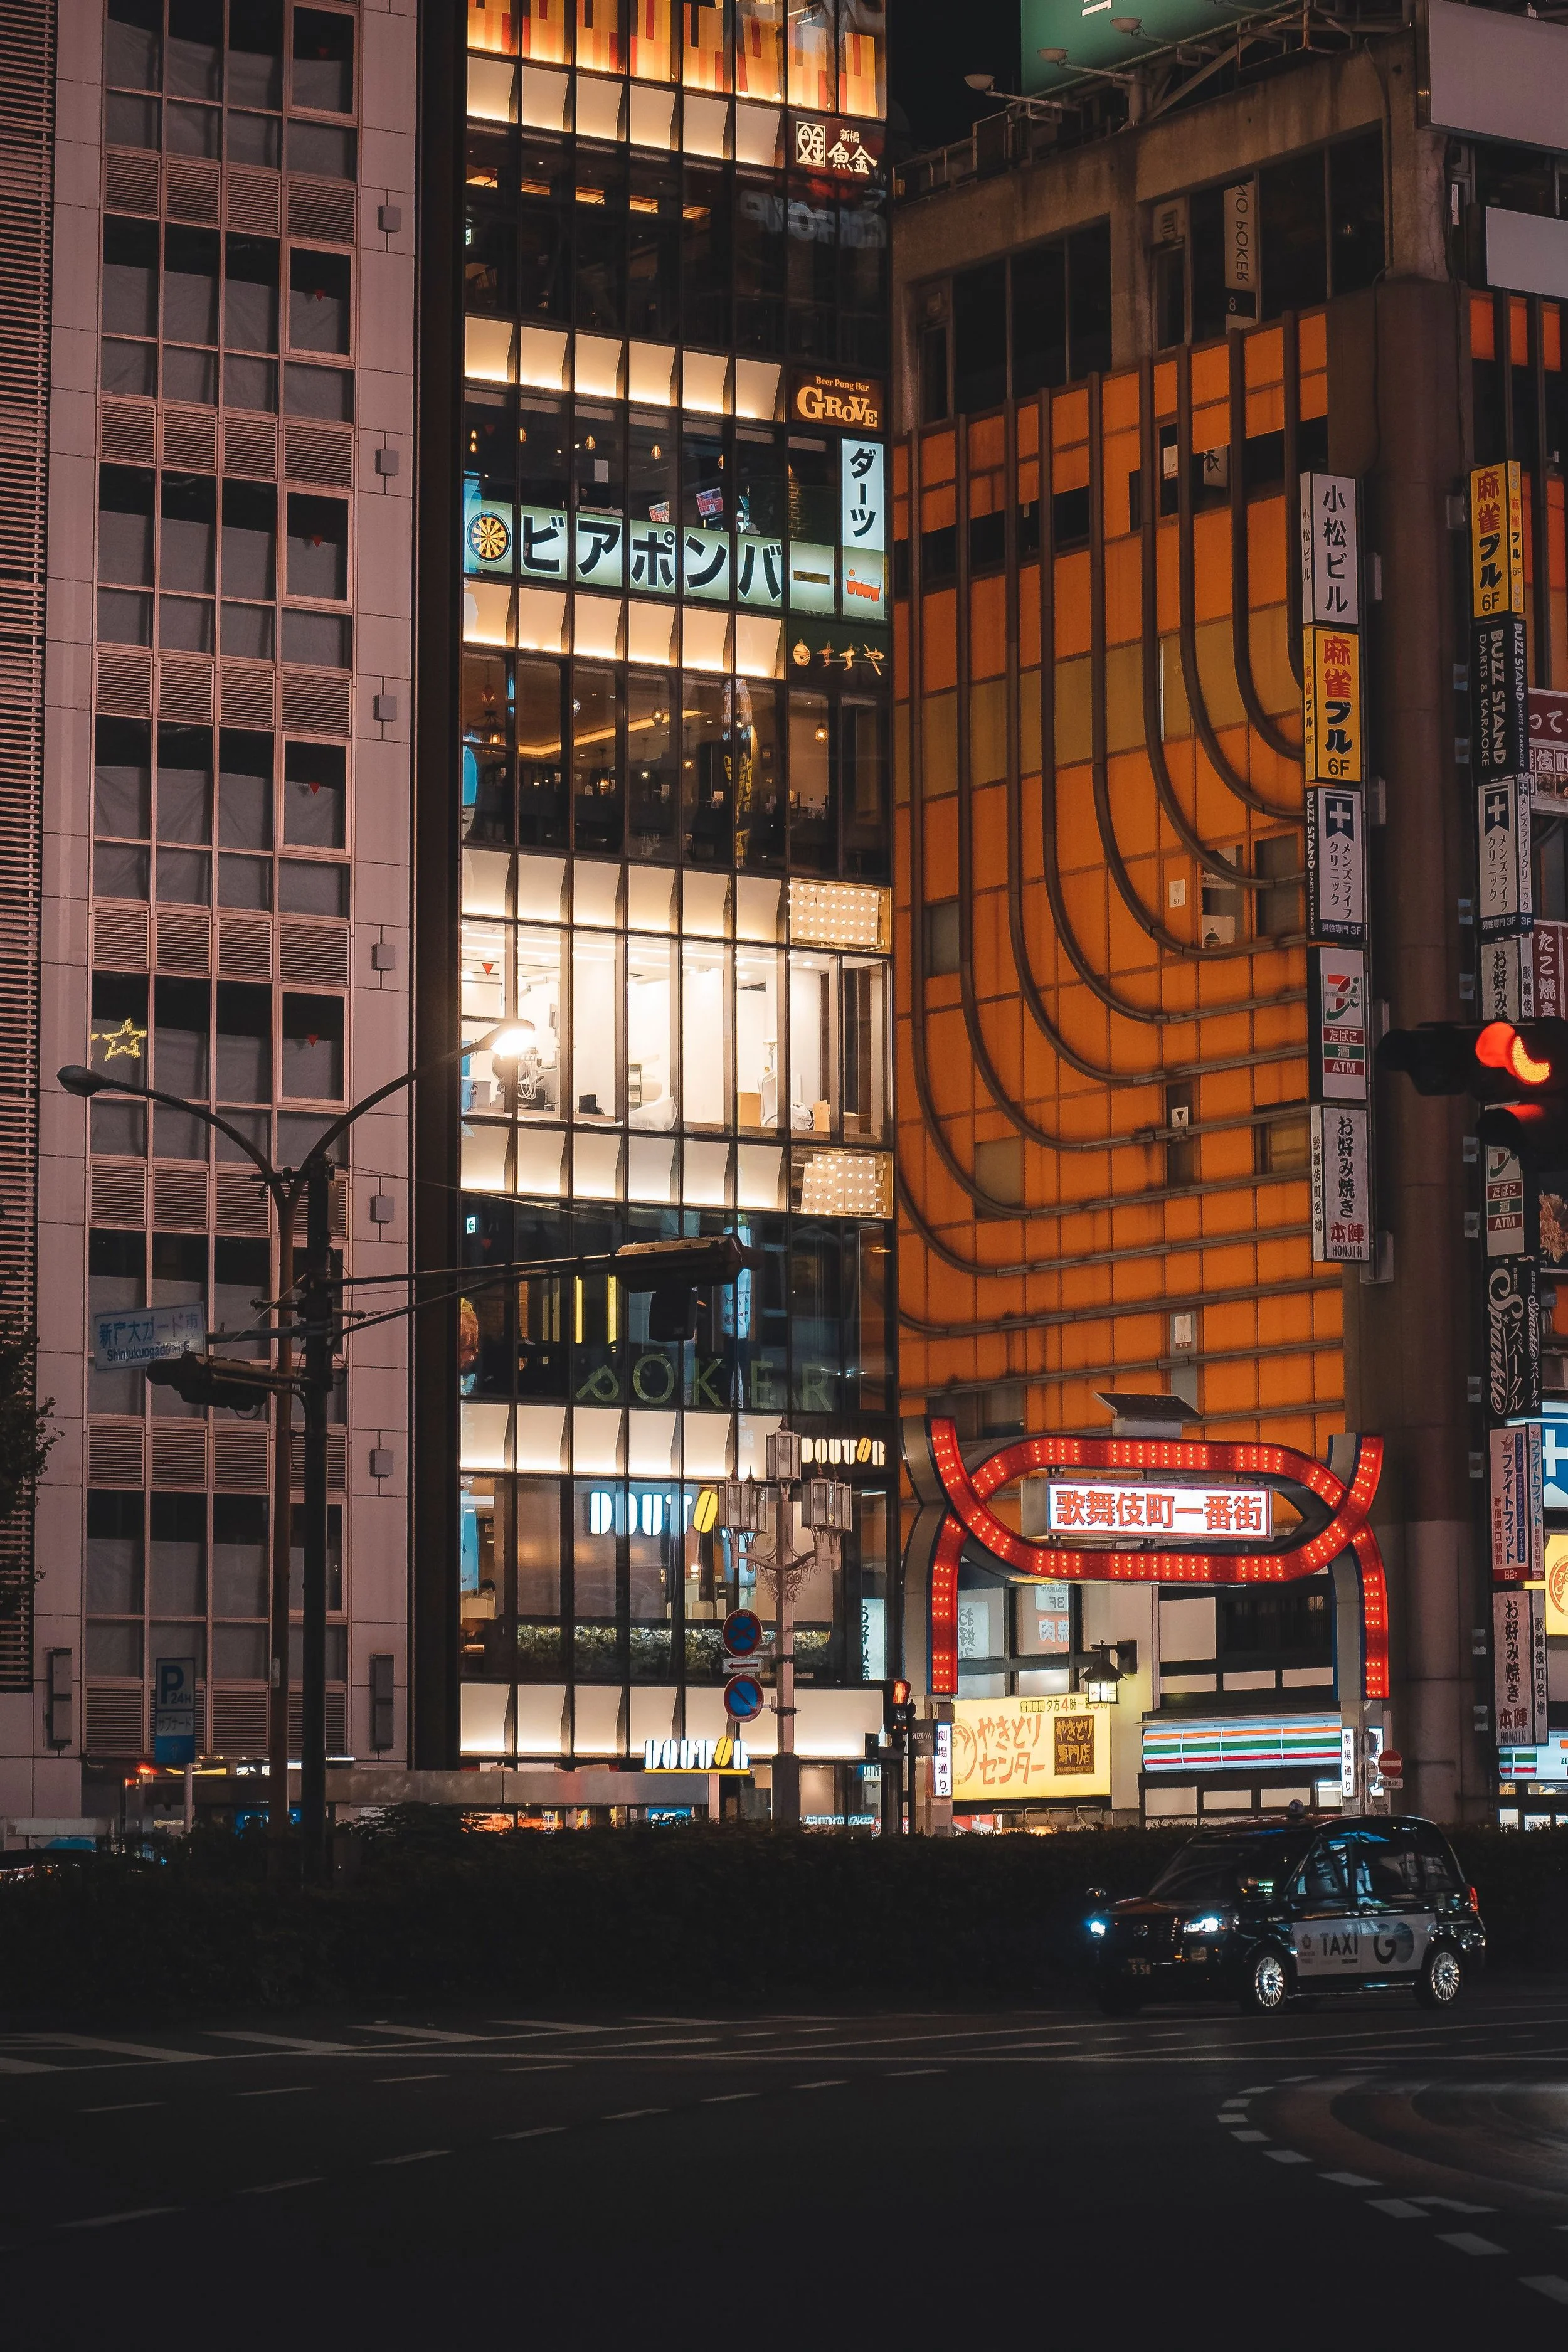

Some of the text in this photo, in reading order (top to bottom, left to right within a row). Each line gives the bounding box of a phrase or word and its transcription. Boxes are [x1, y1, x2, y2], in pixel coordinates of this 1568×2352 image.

[840, 129, 860, 144] 新橋
[827, 141, 877, 175] 魚金
[816, 376, 869, 392] Beer Pong Bar
[849, 447, 877, 538] ダーツ
[1302, 512, 1310, 582] 小松ビル
[1476, 470, 1502, 589] 麻雀ブル
[522, 514, 830, 601] ビアポンバー
[1322, 485, 1348, 614] 小松ビル
[1512, 566, 1522, 576] 6F
[1481, 591, 1500, 612] 6F
[1513, 623, 1523, 655] BUZZ
[1323, 635, 1353, 756] 麻雀ブル
[1491, 630, 1507, 764] BUZZ STAND
[1514, 657, 1524, 702] STAND
[1480, 634, 1490, 767] DARTS & KARAOKE
[1306, 735, 1314, 745] 6F
[1327, 758, 1350, 776] 6F
[1306, 792, 1315, 824] BUZZ
[1307, 826, 1315, 869] STAND
[1329, 841, 1340, 906] クリニック
[1342, 843, 1352, 919] メンズライフ
[1488, 836, 1498, 901] クリニック
[1499, 834, 1508, 913] メンズライフ
[1322, 923, 1362, 935] 男性専門 3F
[1482, 917, 1516, 930] 男性専門 3F
[1521, 917, 1531, 926] 3F
[1522, 966, 1532, 1019] 歌舞伎
[1329, 1029, 1358, 1042] たばこ
[1338, 1046, 1350, 1057] 酒
[1332, 1061, 1357, 1074] ATM
[1312, 1136, 1322, 1233] 歌舞伎町名物
[1337, 1116, 1355, 1219] お好み焼き
[1492, 1185, 1517, 1199] たばこ
[1499, 1201, 1510, 1213] 酒
[1330, 1222, 1365, 1243] 本陣
[1495, 1216, 1515, 1229] ATM
[1332, 1244, 1362, 1258] HONJIN
[1488, 1268, 1525, 1415] Sparkle
[1528, 1295, 1539, 1360] Sparkle
[575, 1353, 832, 1412] POKER
[1507, 1322, 1525, 1414] スパークル
[1530, 1362, 1540, 1409] スパークル
[801, 1437, 886, 1466] DOUTOR
[590, 1490, 719, 1536] DUTO
[1056, 1490, 1263, 1530] 歌舞伎町一番街
[1502, 1454, 1515, 1565] ファイトフィット
[1494, 1496, 1502, 1565] 新宿東口駅前
[1504, 1569, 1518, 1580] B2F
[1505, 1600, 1520, 1703] お好み焼き
[1535, 1618, 1545, 1715] 歌舞伎町名物
[161, 1665, 184, 1705] P
[171, 1693, 191, 1703] 24H
[911, 1732, 931, 1740] SUZUYA
[977, 1714, 1042, 1750] やきとり
[1056, 1718, 1093, 1742] やきとり
[1499, 1707, 1528, 1729] 本陣
[1500, 1730, 1526, 1744] HONJIN
[645, 1735, 750, 1770] DOUTOR
[938, 1729, 948, 1790] 劇場通り
[979, 1752, 1046, 1785] センター
[1057, 1743, 1091, 1766] 専門店
[1343, 1734, 1352, 1791] 劇場通り
[1320, 1932, 1358, 1957] TAXI
[1374, 1922, 1414, 1964] GO
